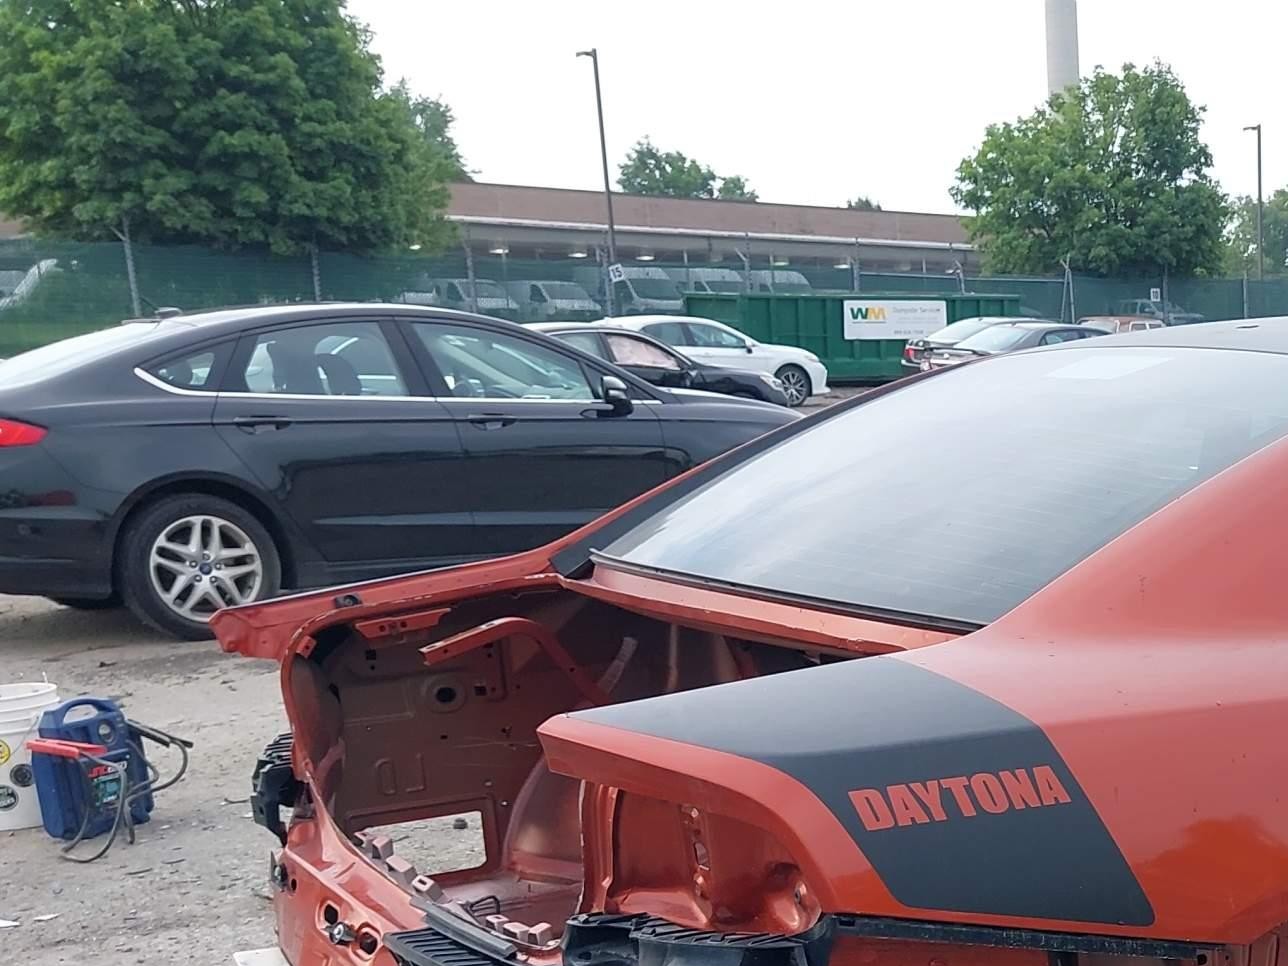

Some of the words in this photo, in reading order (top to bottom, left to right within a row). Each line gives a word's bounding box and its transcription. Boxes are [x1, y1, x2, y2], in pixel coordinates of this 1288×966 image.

[611, 266, 623, 279] 15
[850, 307, 886, 320] WM
[848, 765, 1072, 831] DAYTONA
